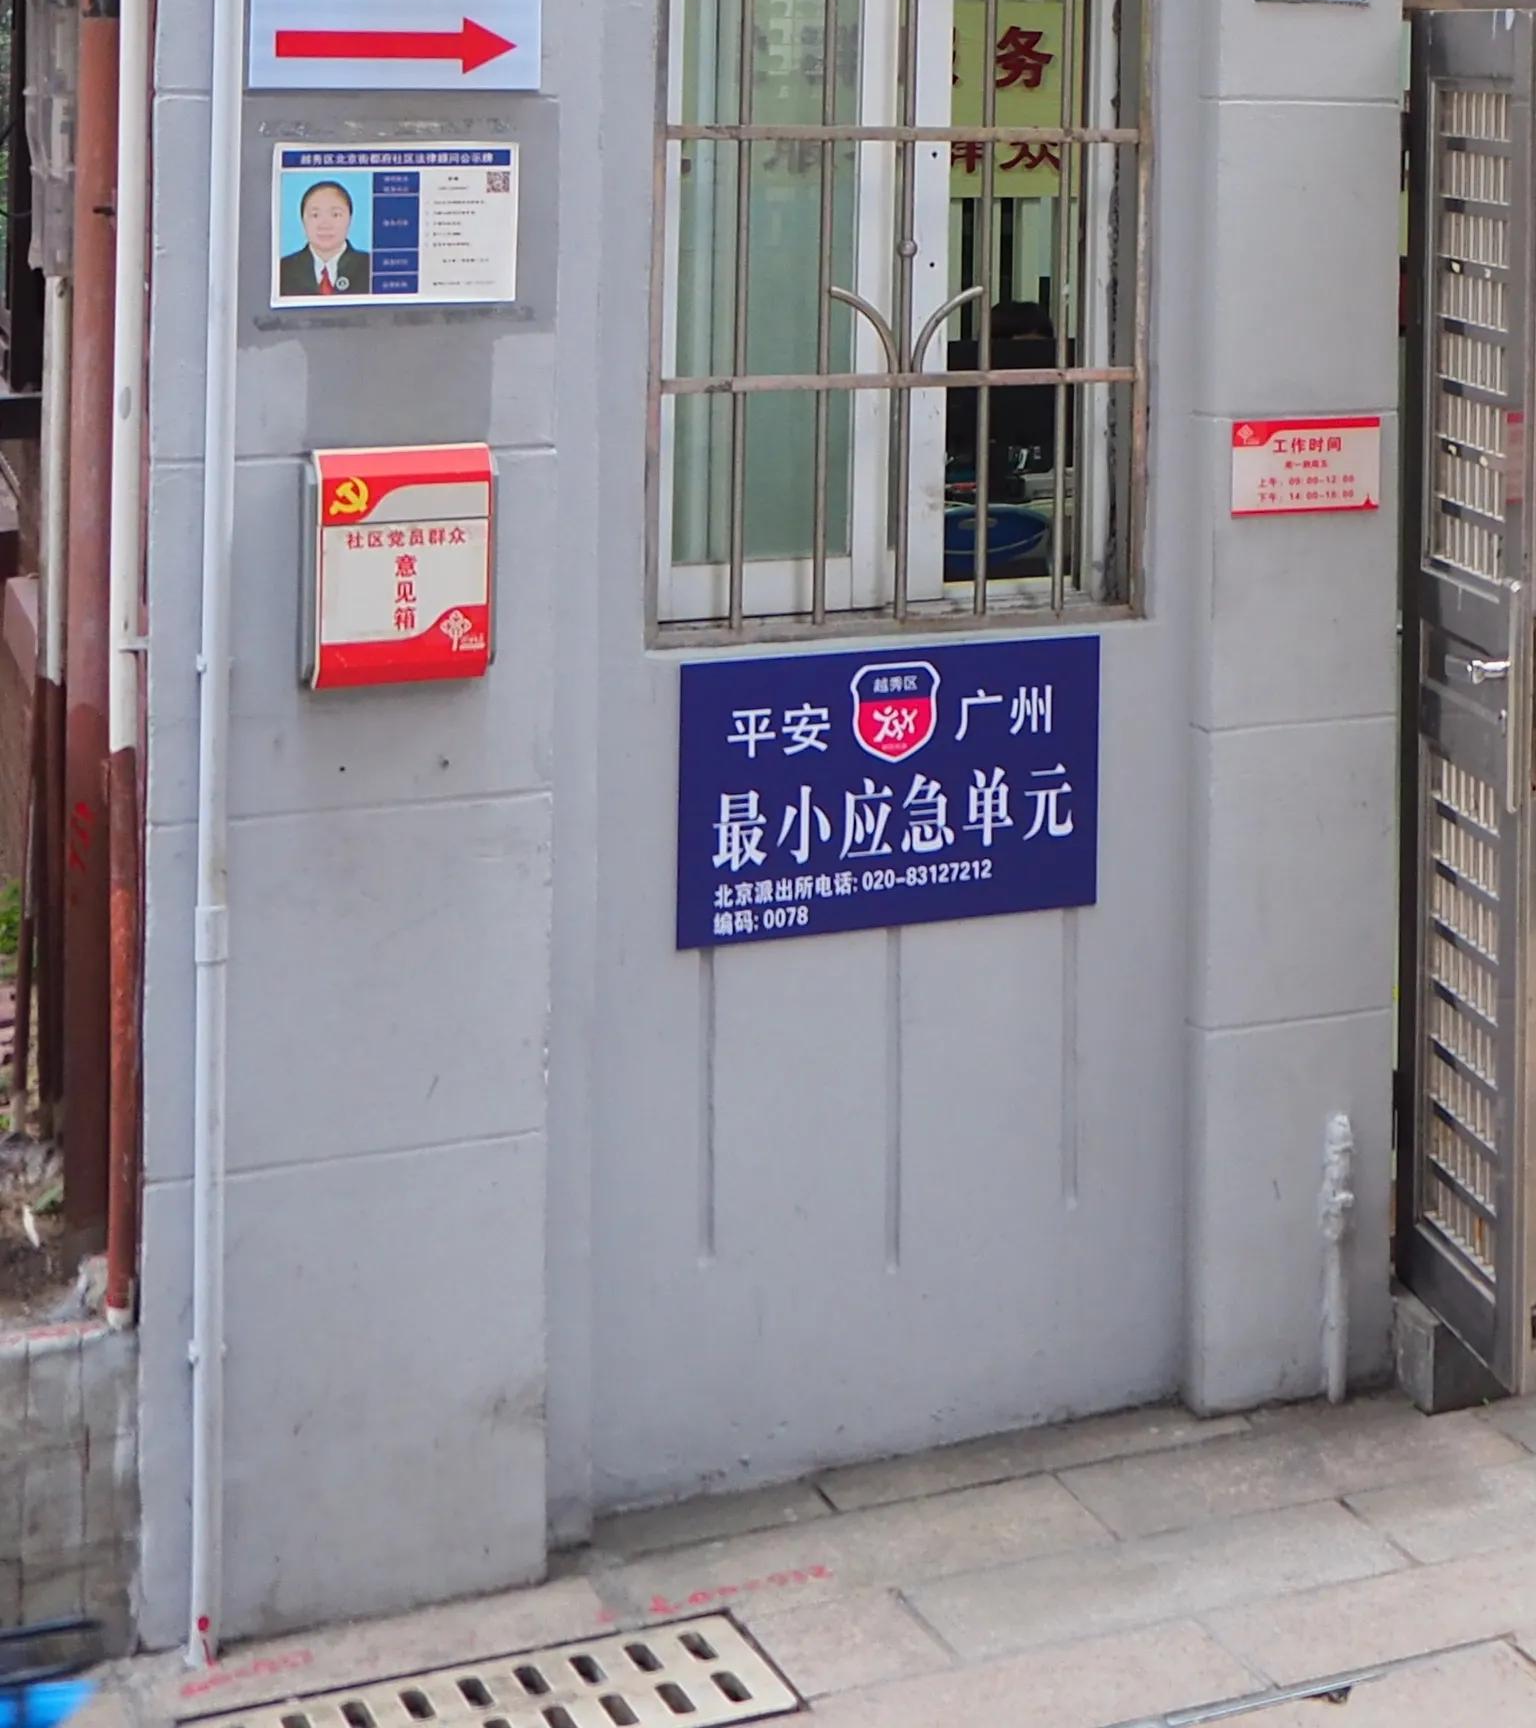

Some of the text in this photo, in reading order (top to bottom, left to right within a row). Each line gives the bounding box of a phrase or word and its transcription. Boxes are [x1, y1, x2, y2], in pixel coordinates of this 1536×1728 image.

[1273, 436, 1342, 453] 工作时间
[347, 527, 466, 550] 社区党员群众
[395, 554, 417, 631] 意见箱
[873, 675, 918, 693] 越秀区
[727, 684, 1053, 759] 平安 广州
[712, 763, 1073, 872] 最小应急单元
